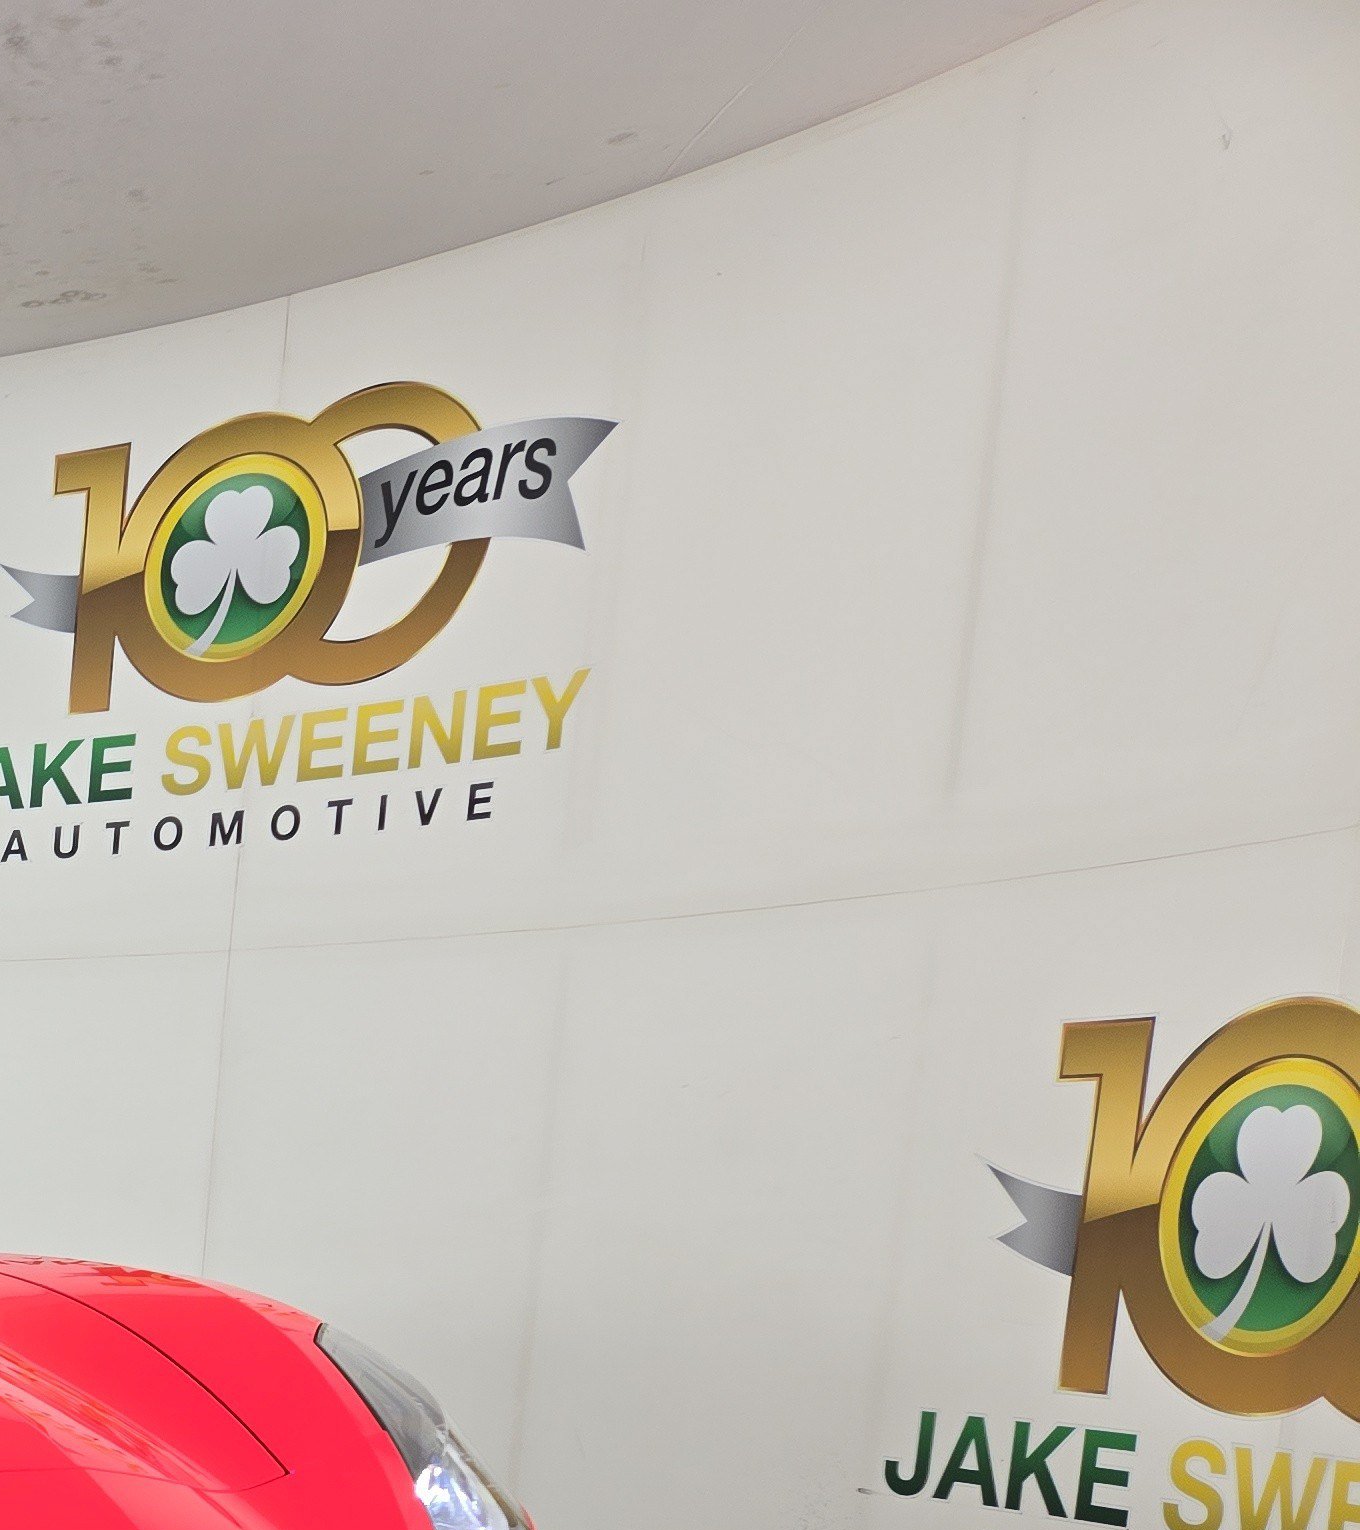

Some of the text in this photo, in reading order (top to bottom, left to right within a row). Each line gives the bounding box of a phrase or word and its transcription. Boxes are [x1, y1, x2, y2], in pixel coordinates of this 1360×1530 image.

[52, 381, 557, 716] 100 years
[161, 668, 592, 796] SWEENEY
[0, 782, 495, 863] AUTOMOTIVE
[1057, 997, 1360, 1422] 10
[885, 1410, 1138, 1529] JAKE
